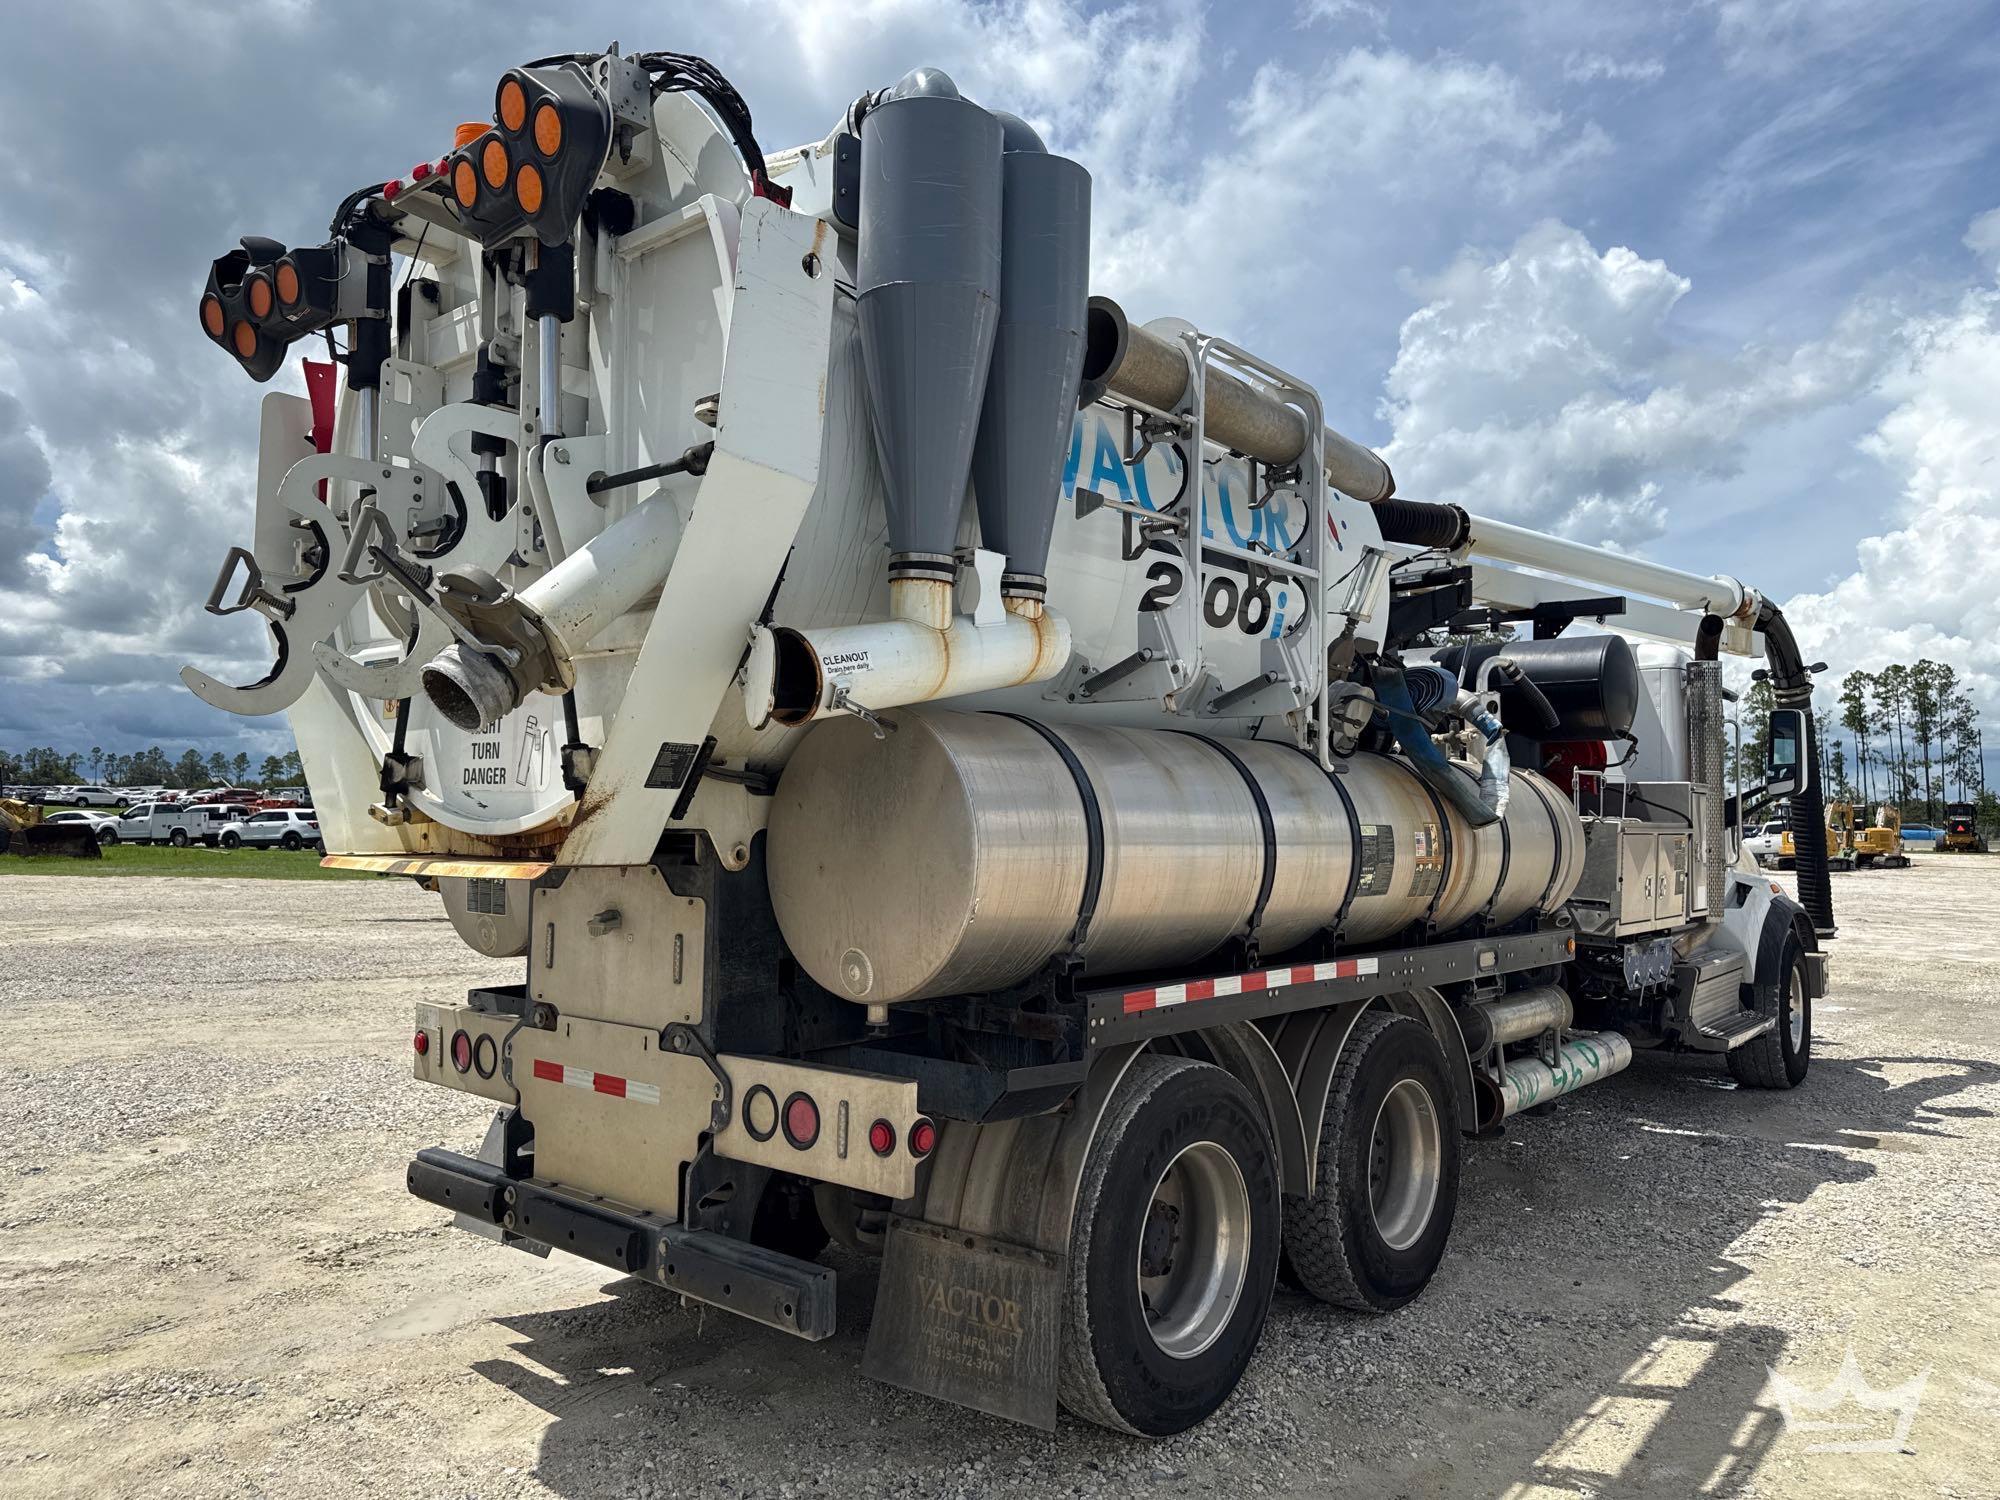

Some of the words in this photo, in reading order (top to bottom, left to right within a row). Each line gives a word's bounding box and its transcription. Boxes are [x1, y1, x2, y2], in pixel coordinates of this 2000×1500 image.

[1062, 408, 1293, 553] VACOR
[1138, 561, 1288, 640] 200i
[823, 651, 869, 666] CLEANOUT
[827, 666, 843, 674] Drain
[857, 663, 870, 671] daily
[471, 742, 500, 760] TURN
[463, 767, 507, 785] DANGER
[917, 1274, 1023, 1330] VACTOR
[921, 1322, 960, 1344] VACTOR
